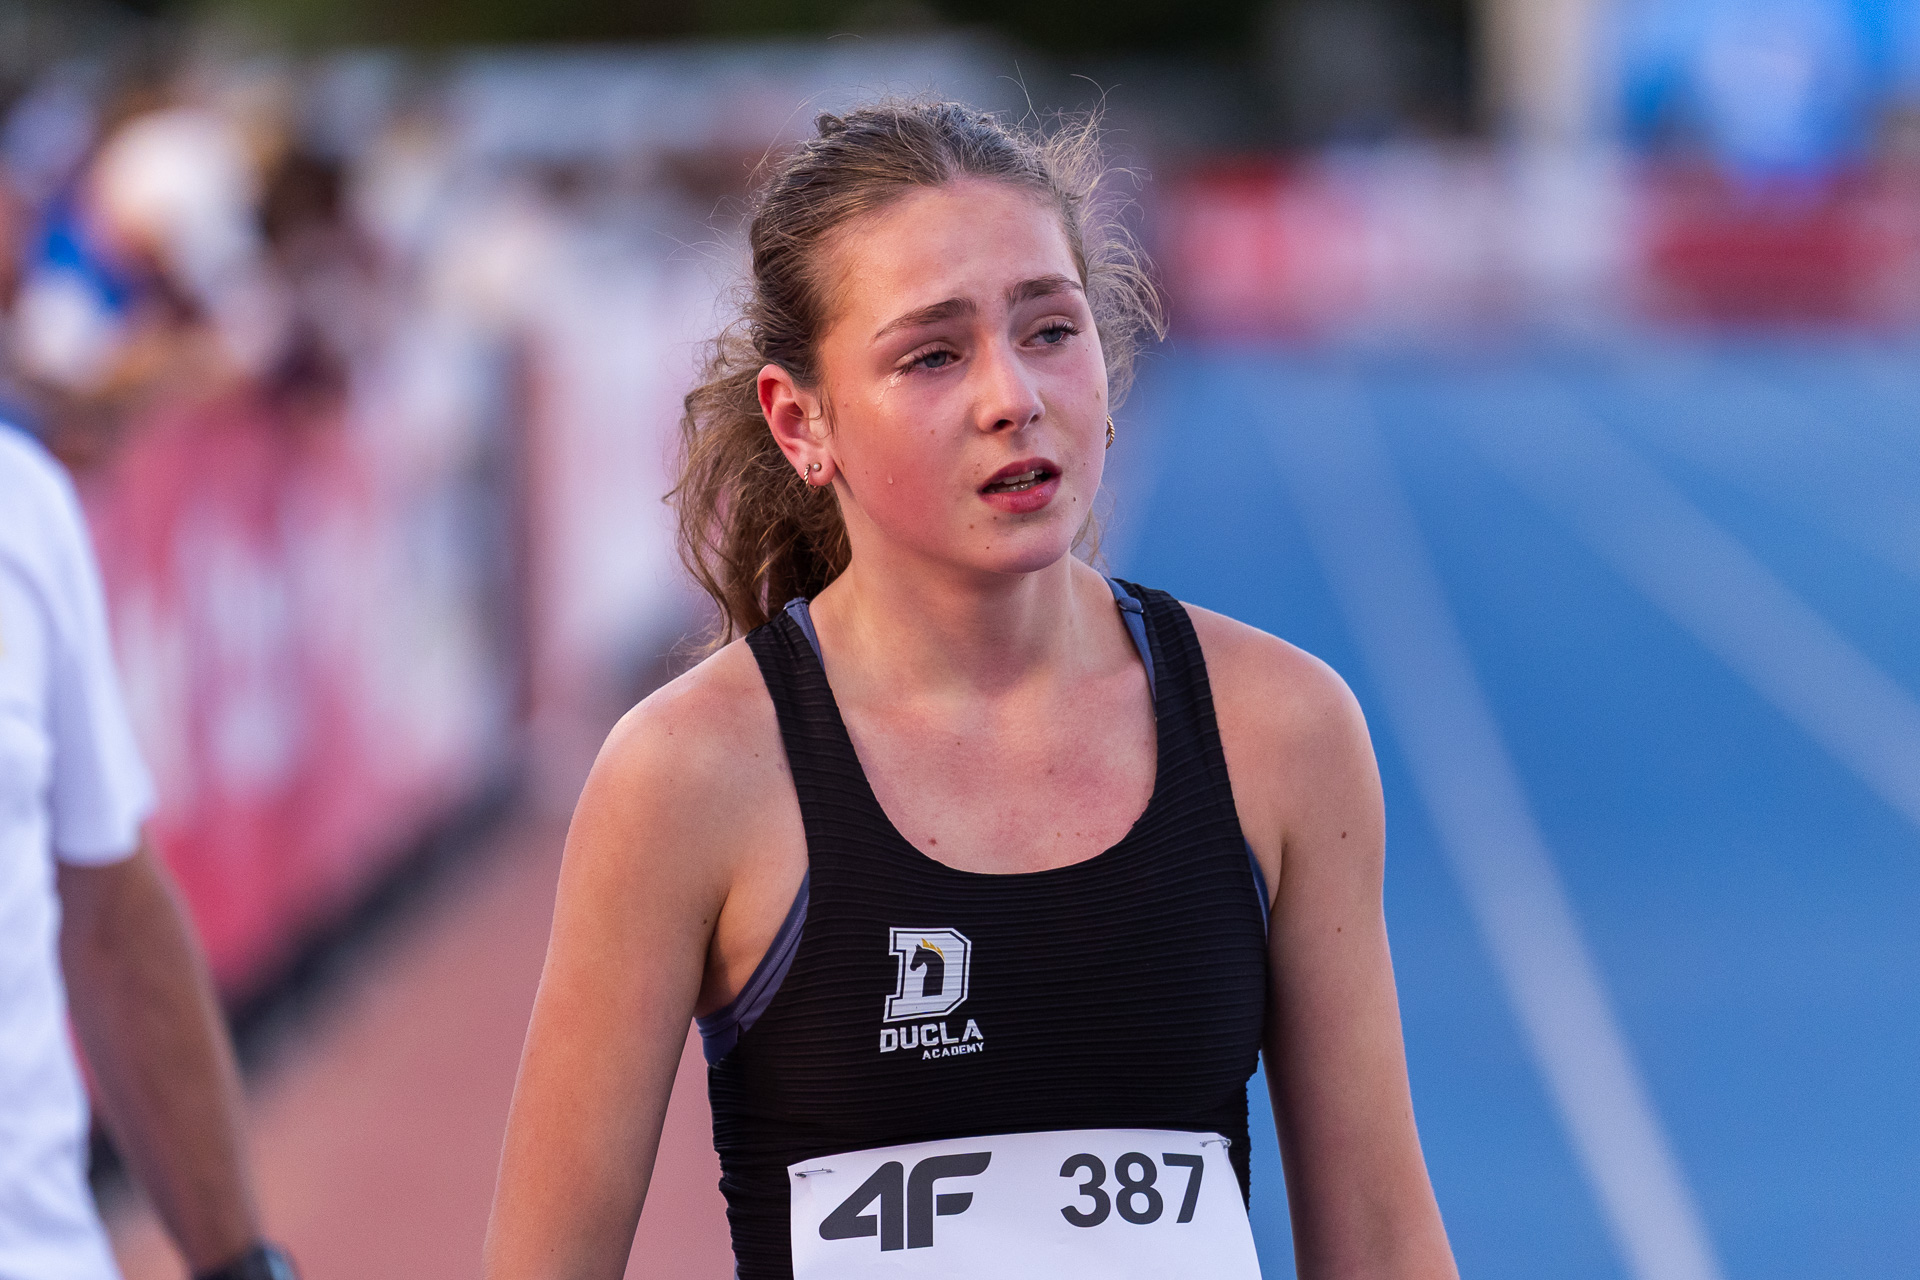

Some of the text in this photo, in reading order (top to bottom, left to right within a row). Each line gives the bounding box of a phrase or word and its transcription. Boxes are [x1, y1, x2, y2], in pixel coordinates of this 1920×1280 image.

[883, 927, 972, 1023] D
[880, 1019, 984, 1053] DUCLA
[922, 1042, 985, 1060] ACADEMY
[818, 1151, 992, 1252] 4F
[1059, 1151, 1204, 1228] 387
